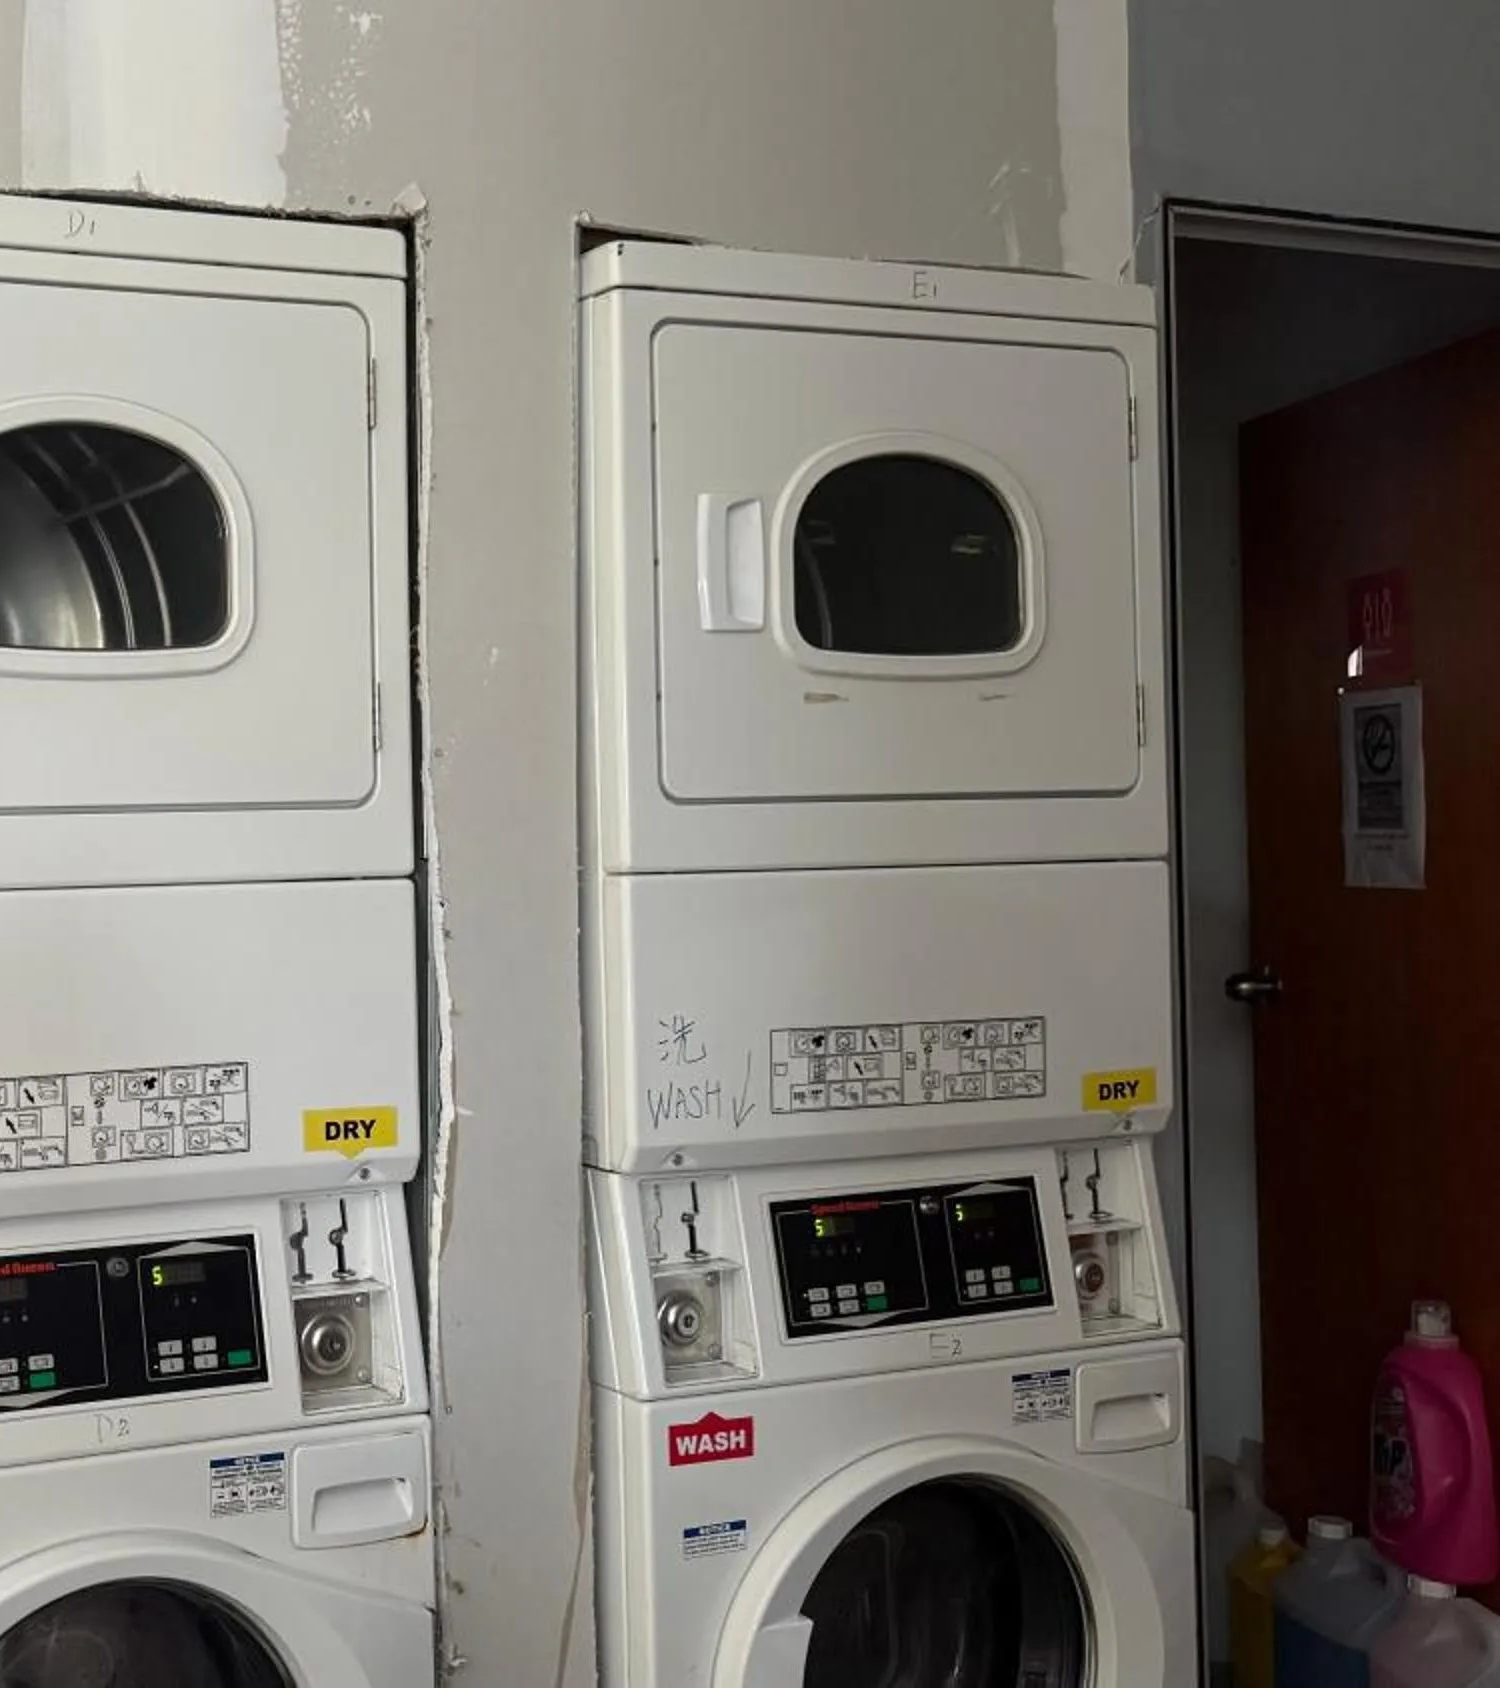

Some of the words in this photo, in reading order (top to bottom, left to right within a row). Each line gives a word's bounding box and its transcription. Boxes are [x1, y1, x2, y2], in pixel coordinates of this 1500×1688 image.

[659, 1014, 707, 1066] 洗
[647, 1078, 722, 1129] WASH
[1098, 1079, 1139, 1101] DRY
[325, 1118, 377, 1141] DRY
[675, 1429, 746, 1457] WASH
